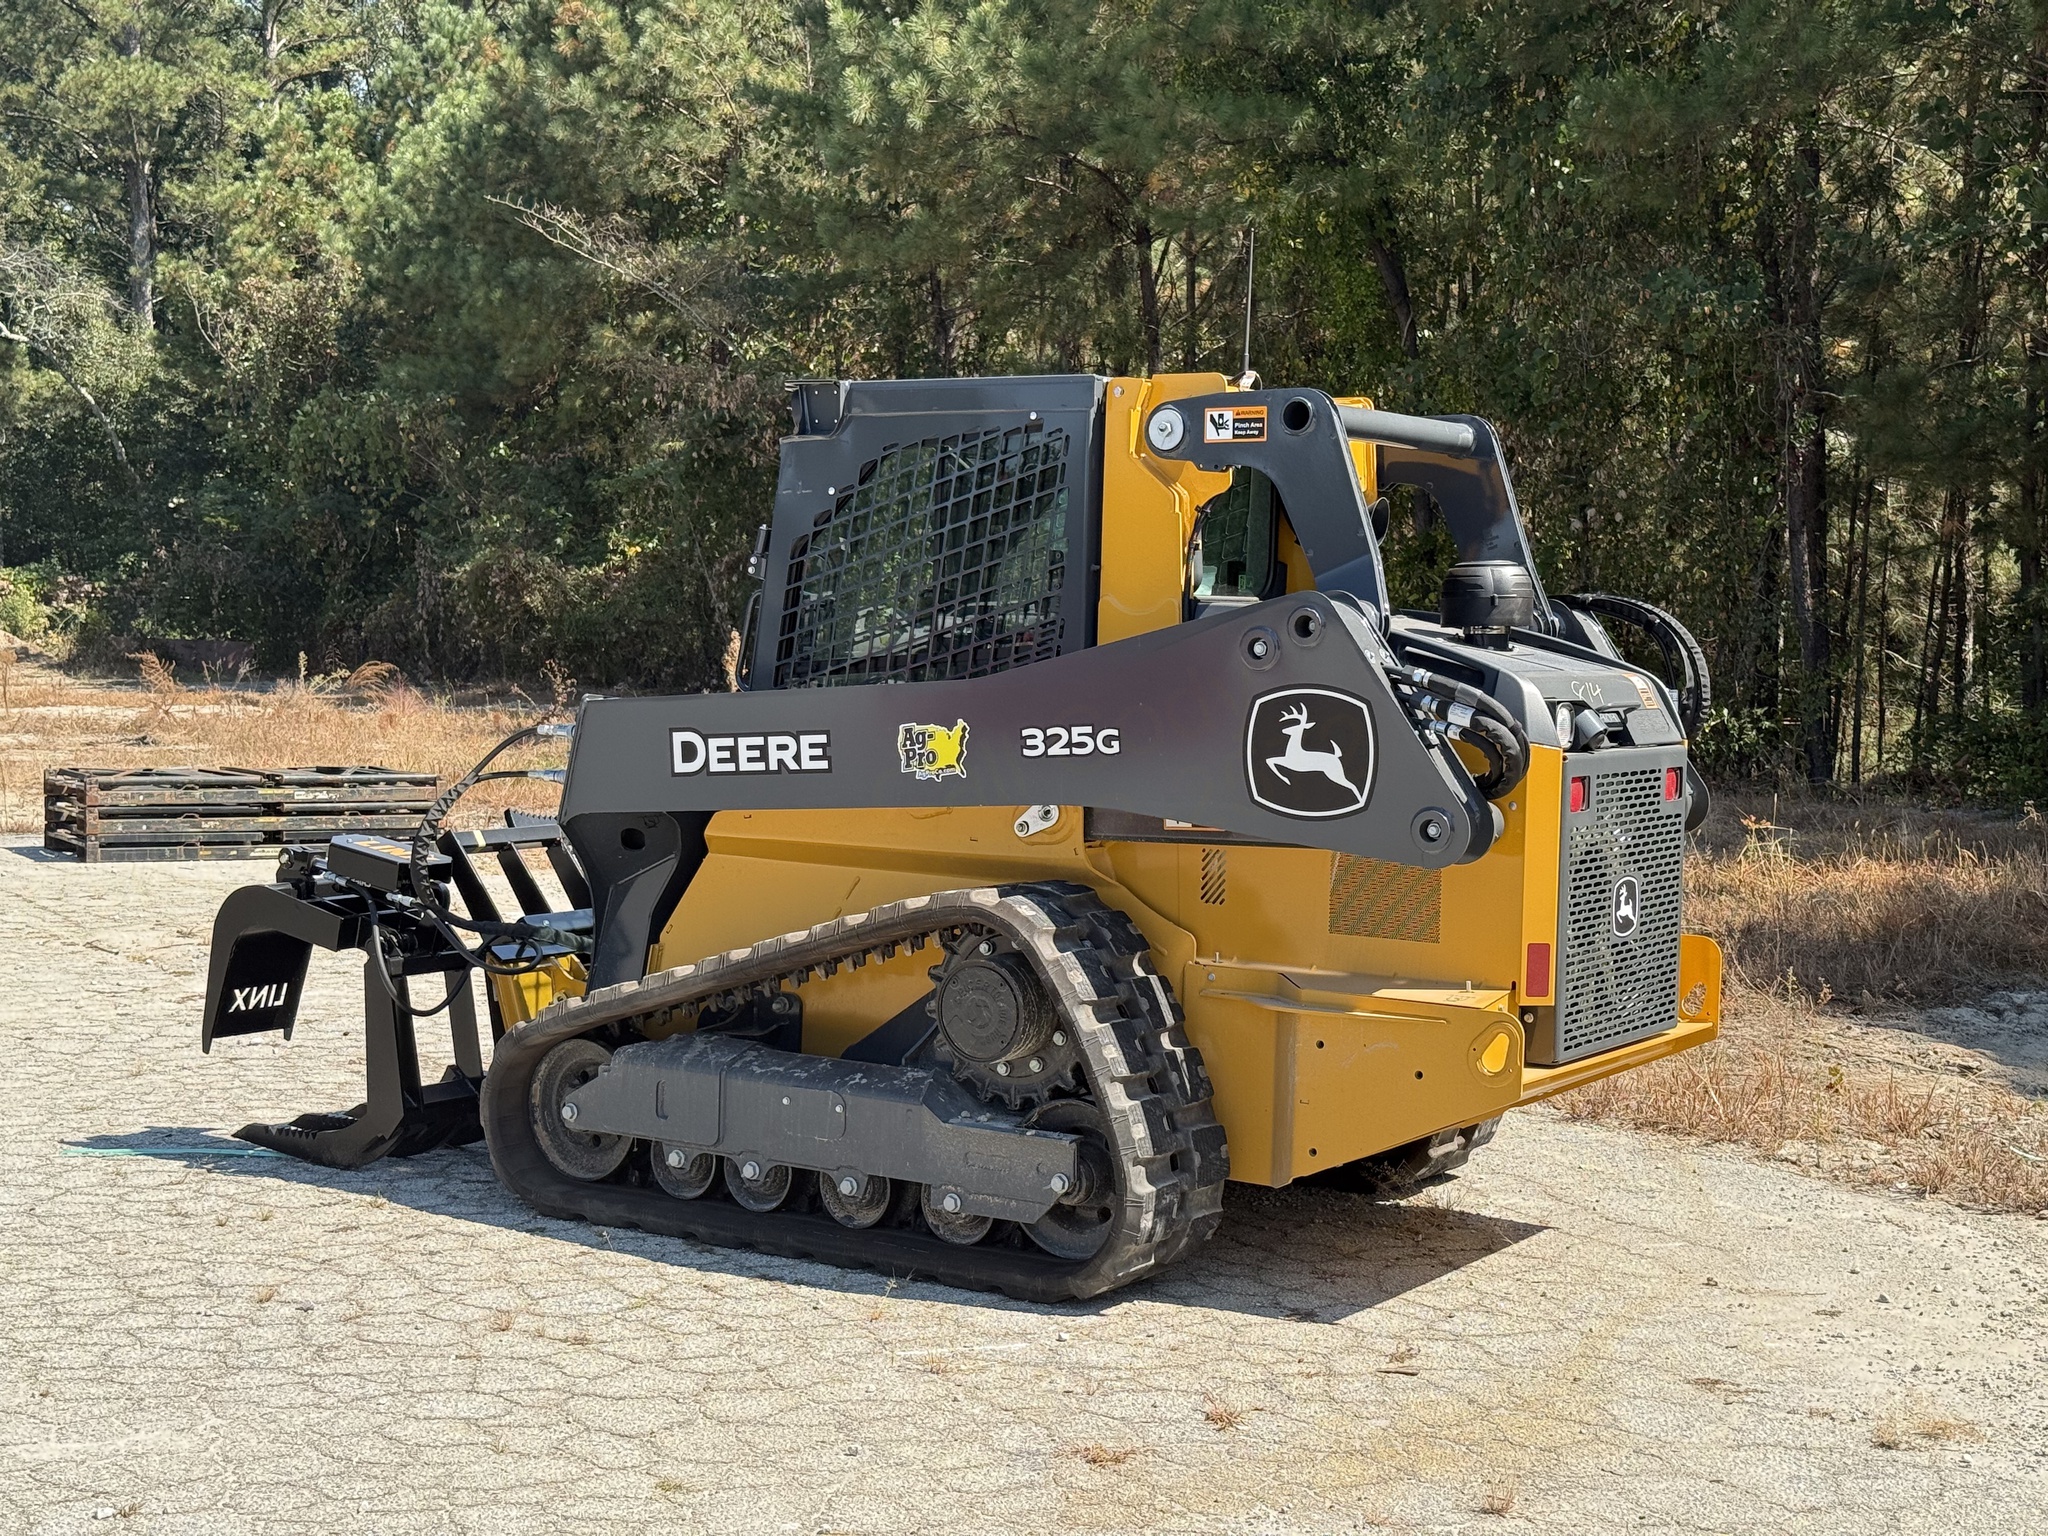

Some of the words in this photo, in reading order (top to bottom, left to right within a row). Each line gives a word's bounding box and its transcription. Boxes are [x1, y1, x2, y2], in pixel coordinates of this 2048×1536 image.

[672, 731, 829, 773] DEERE
[902, 728, 934, 750] Ag-
[1021, 726, 1120, 757] 325G
[904, 748, 937, 768] Pro
